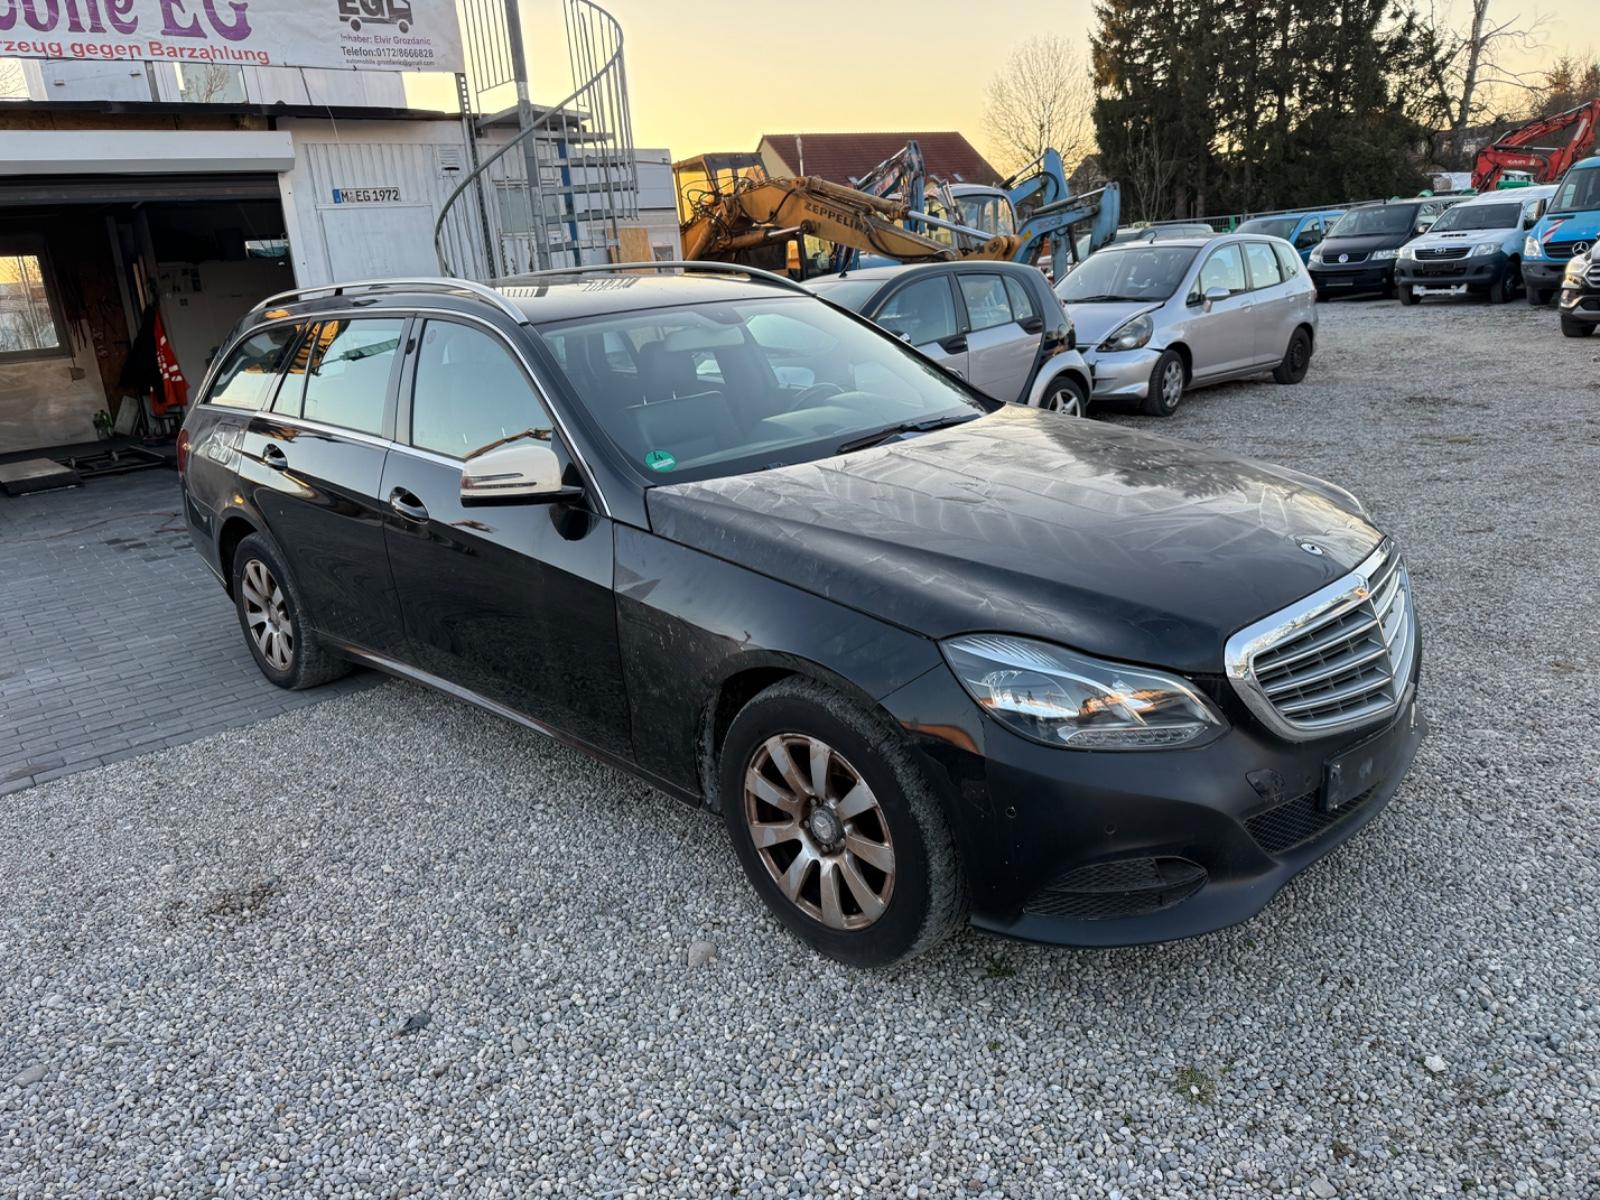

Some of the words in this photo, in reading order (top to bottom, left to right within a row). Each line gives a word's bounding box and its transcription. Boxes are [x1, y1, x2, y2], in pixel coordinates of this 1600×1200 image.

[340, 33, 372, 44] Inhaber:
[374, 35, 392, 45] Elvir
[393, 36, 432, 45] Grozdanic
[0, 39, 63, 57] zeug
[70, 42, 142, 59] gegen
[148, 41, 271, 66] Barzahlung
[341, 190, 351, 203] M
[355, 190, 371, 203] EG
[372, 189, 400, 203] 1972
